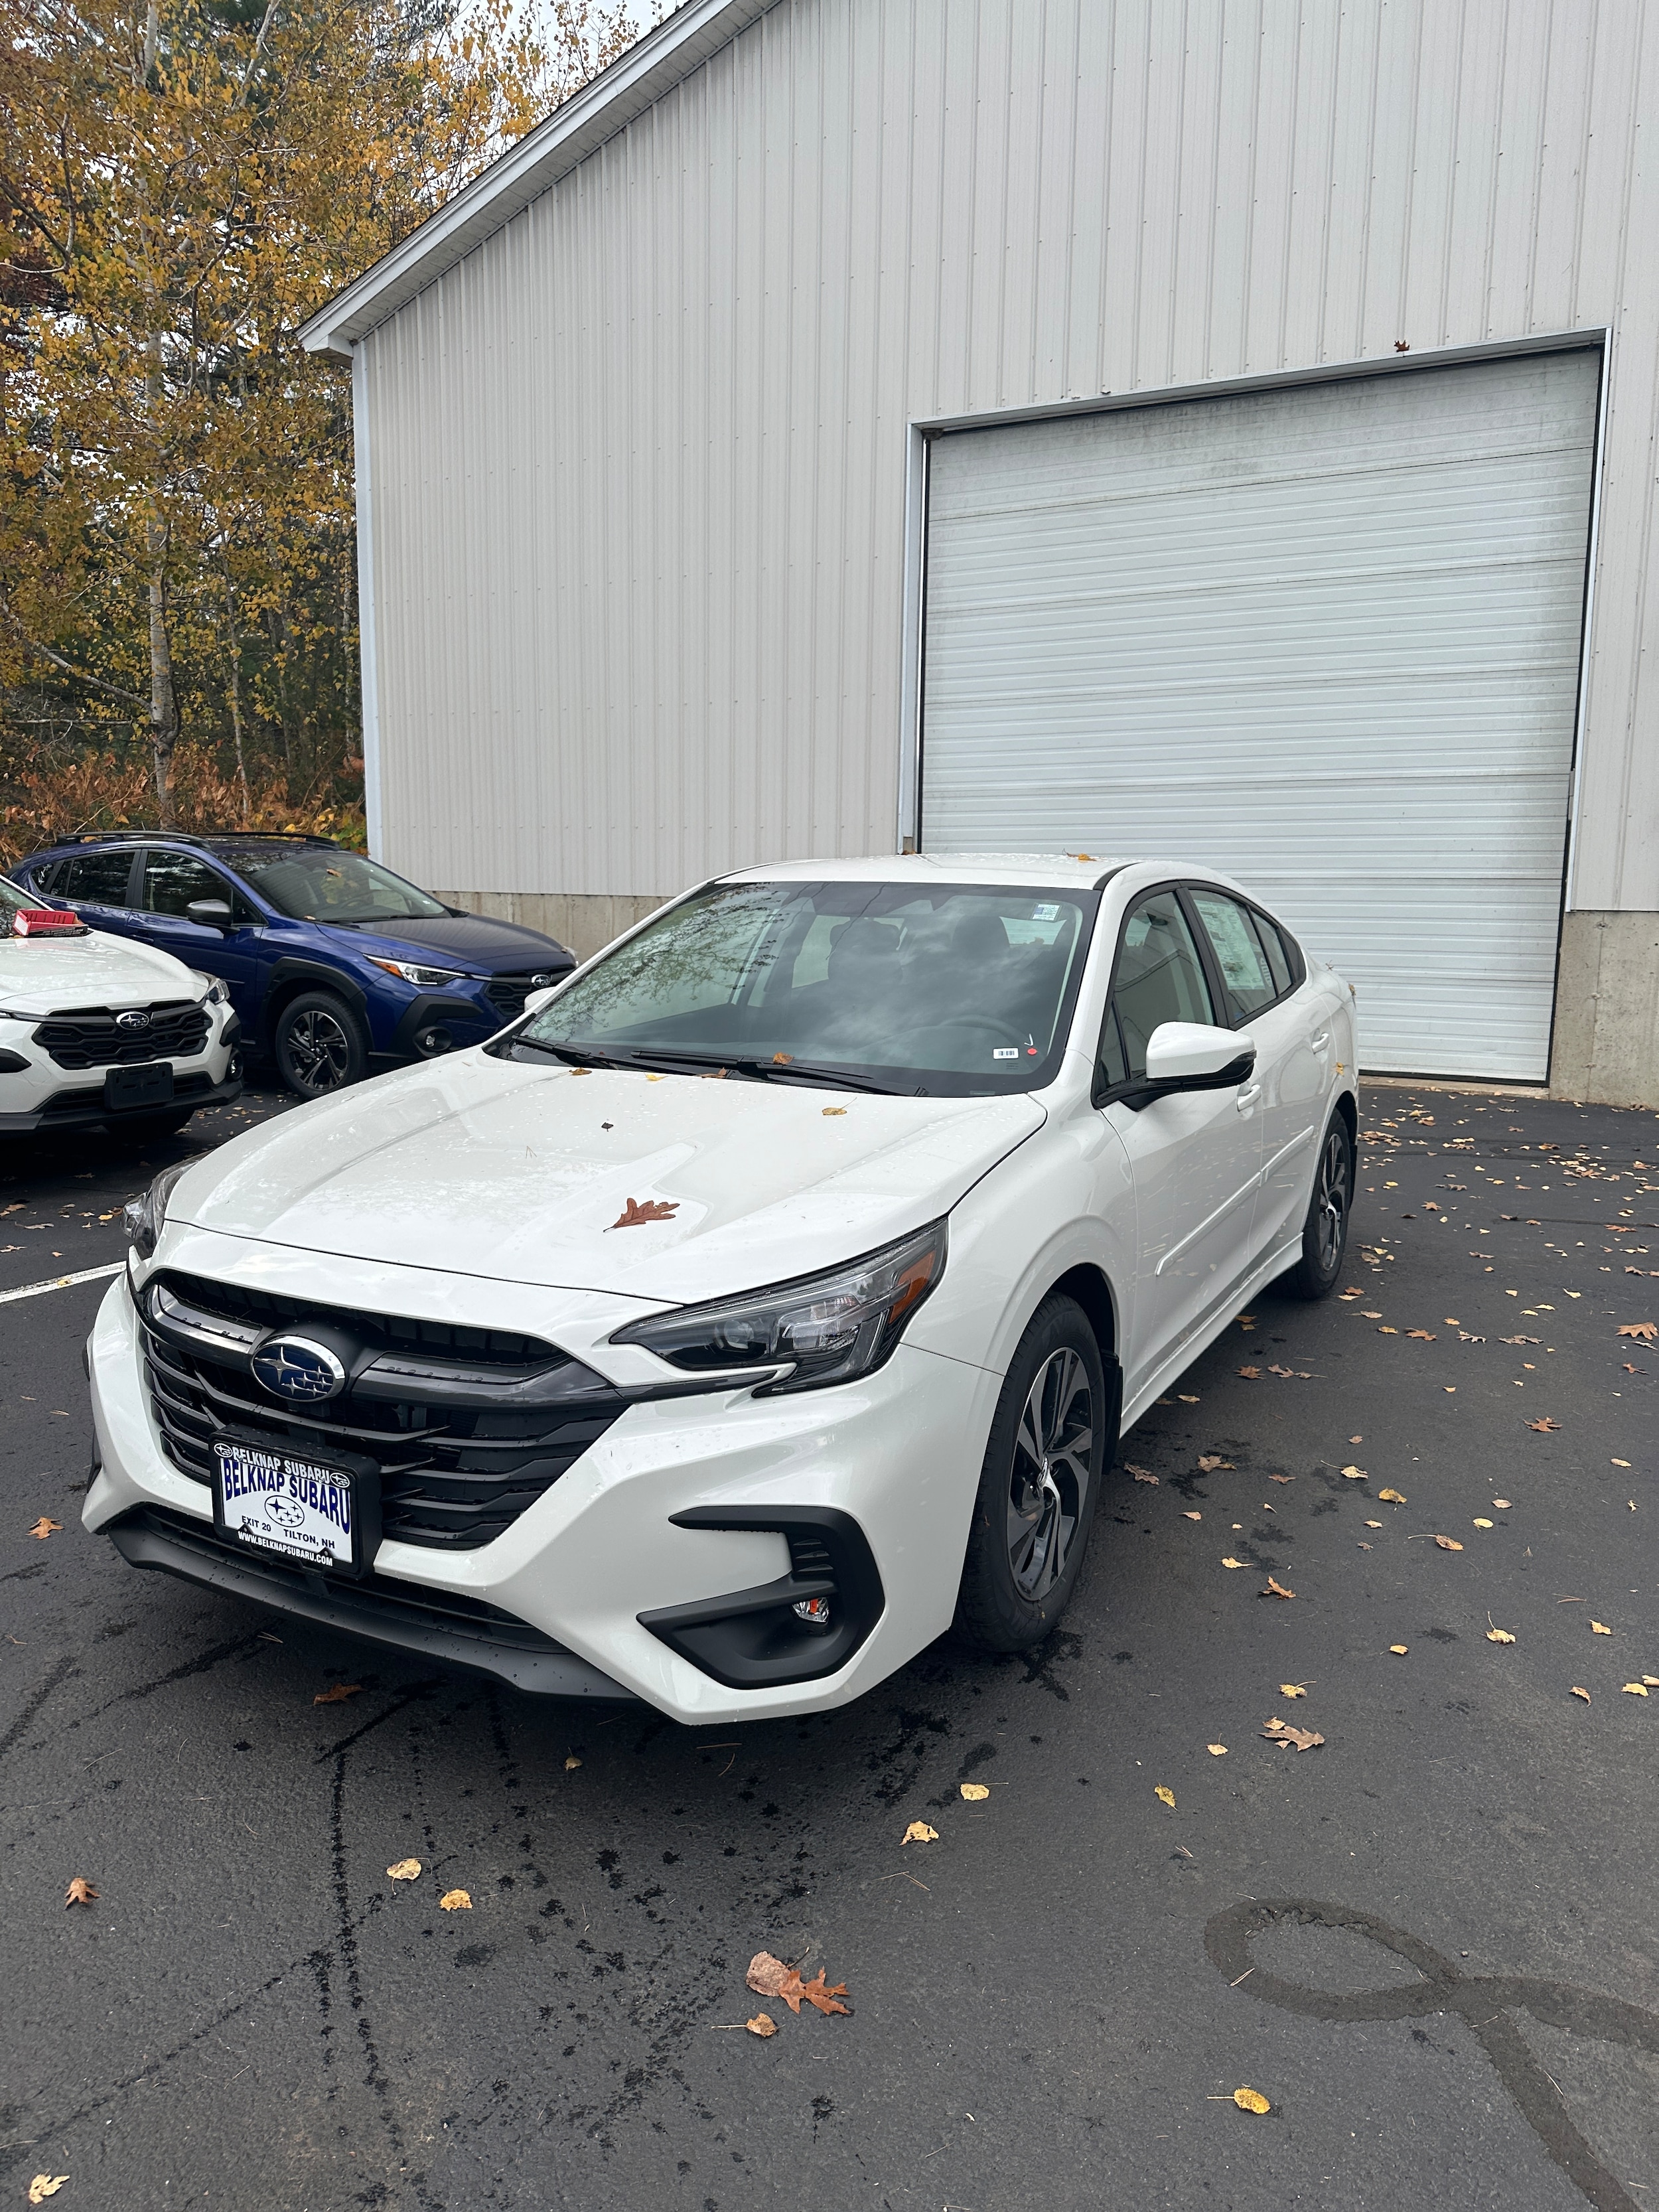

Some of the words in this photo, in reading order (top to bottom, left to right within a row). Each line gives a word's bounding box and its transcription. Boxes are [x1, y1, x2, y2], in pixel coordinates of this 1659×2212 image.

[232, 1447, 281, 1471] BELKNAP
[284, 1460, 330, 1484] SUBARU
[224, 1459, 285, 1501] BELKNAP
[289, 1475, 350, 1534] SUBARU
[242, 1515, 259, 1528] EXIT
[261, 1522, 271, 1532] 20
[283, 1528, 319, 1546] TILTON,
[322, 1538, 335, 1548] NH
[238, 1531, 333, 1567] WWW.BELKNAPSUBARU.COM
